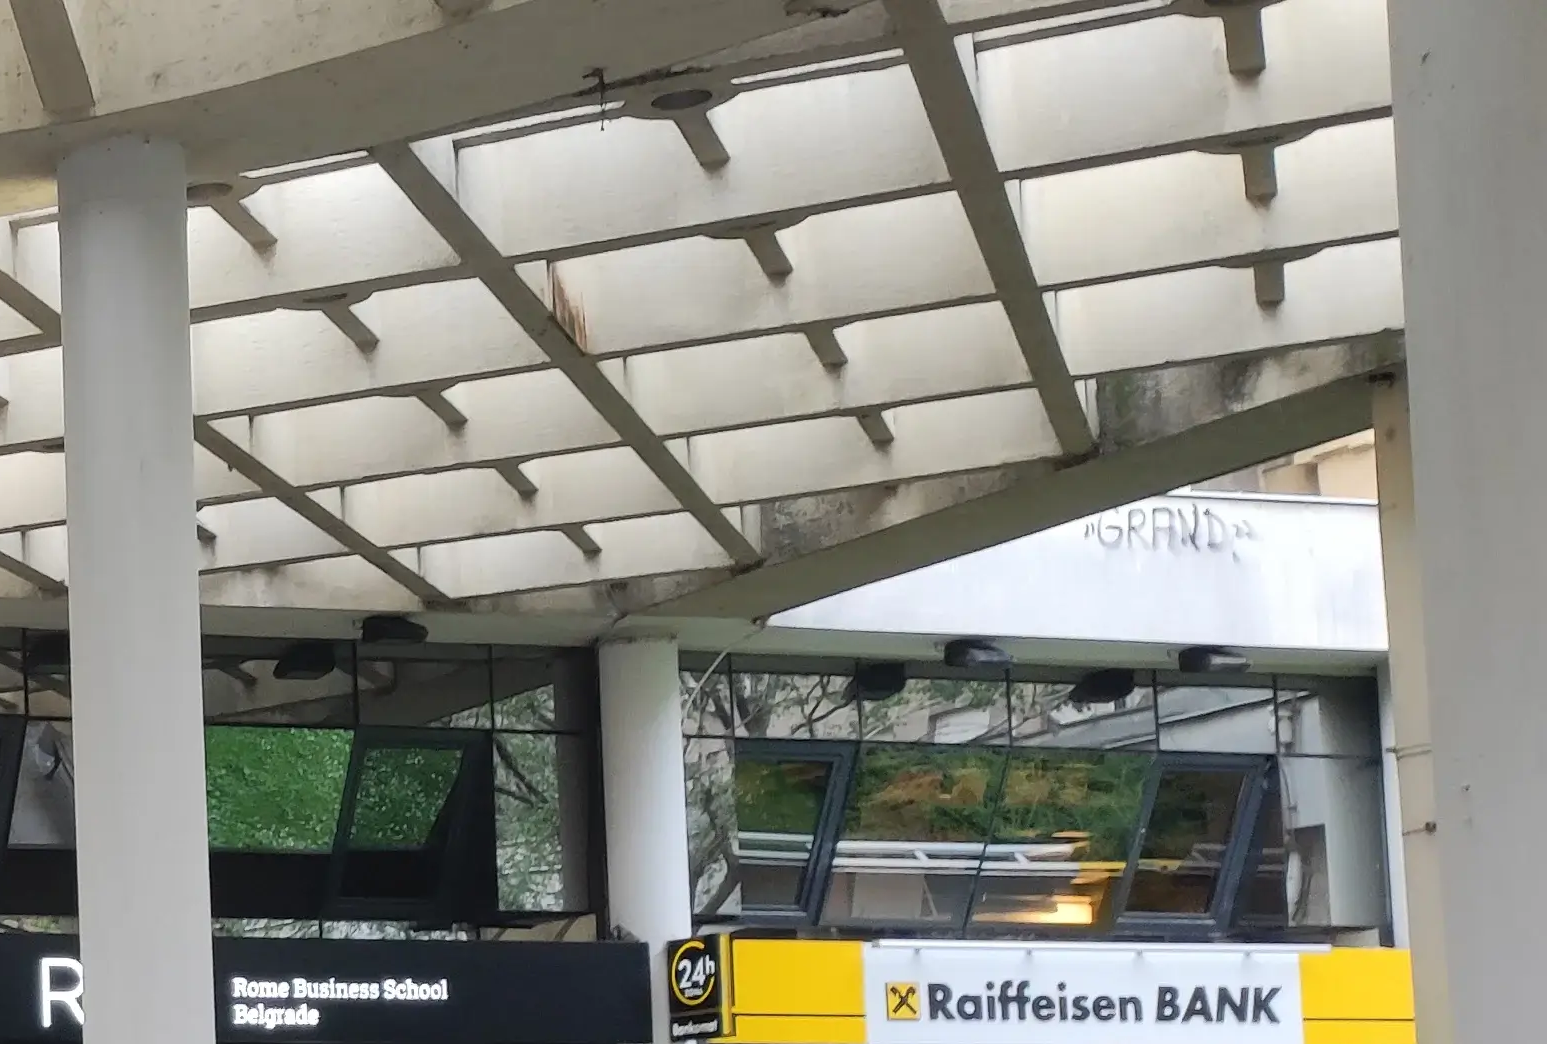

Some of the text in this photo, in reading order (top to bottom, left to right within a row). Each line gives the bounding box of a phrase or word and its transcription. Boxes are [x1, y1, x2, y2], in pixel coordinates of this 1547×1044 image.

[677, 954, 715, 989] 24h
[232, 977, 449, 1000] Rome Business School
[927, 981, 1282, 1023] Raiffeisen BANK
[233, 1003, 320, 1029] Belgrade
